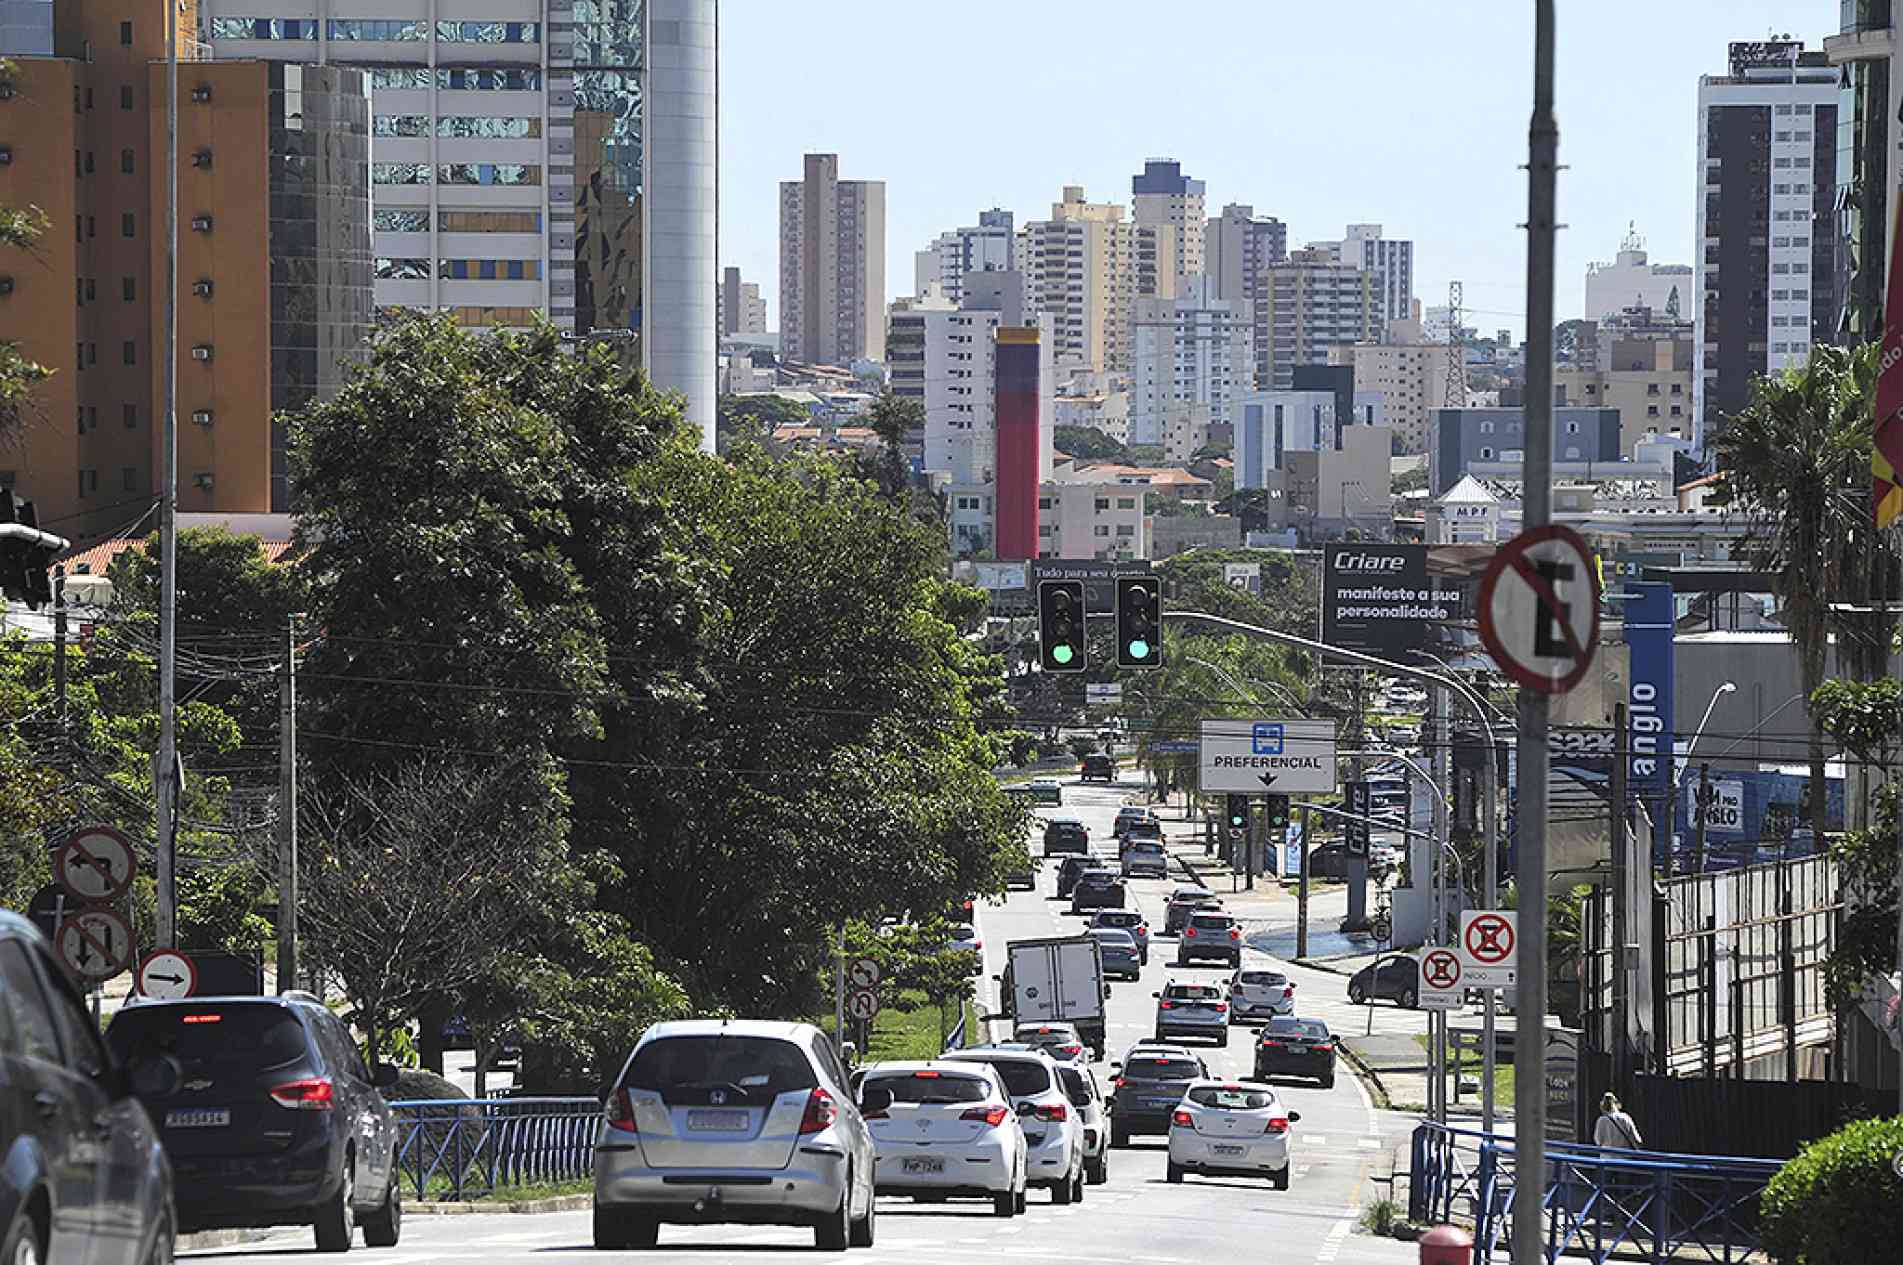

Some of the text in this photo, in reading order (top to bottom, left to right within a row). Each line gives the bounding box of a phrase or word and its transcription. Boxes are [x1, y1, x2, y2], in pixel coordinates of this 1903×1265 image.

[1334, 551, 1406, 570] Criare
[1336, 586, 1461, 601] manifeste a sua
[1336, 604, 1449, 620] personalidade
[1629, 682, 1663, 777] anglo
[1213, 755, 1322, 769] PREFERENCIAL
